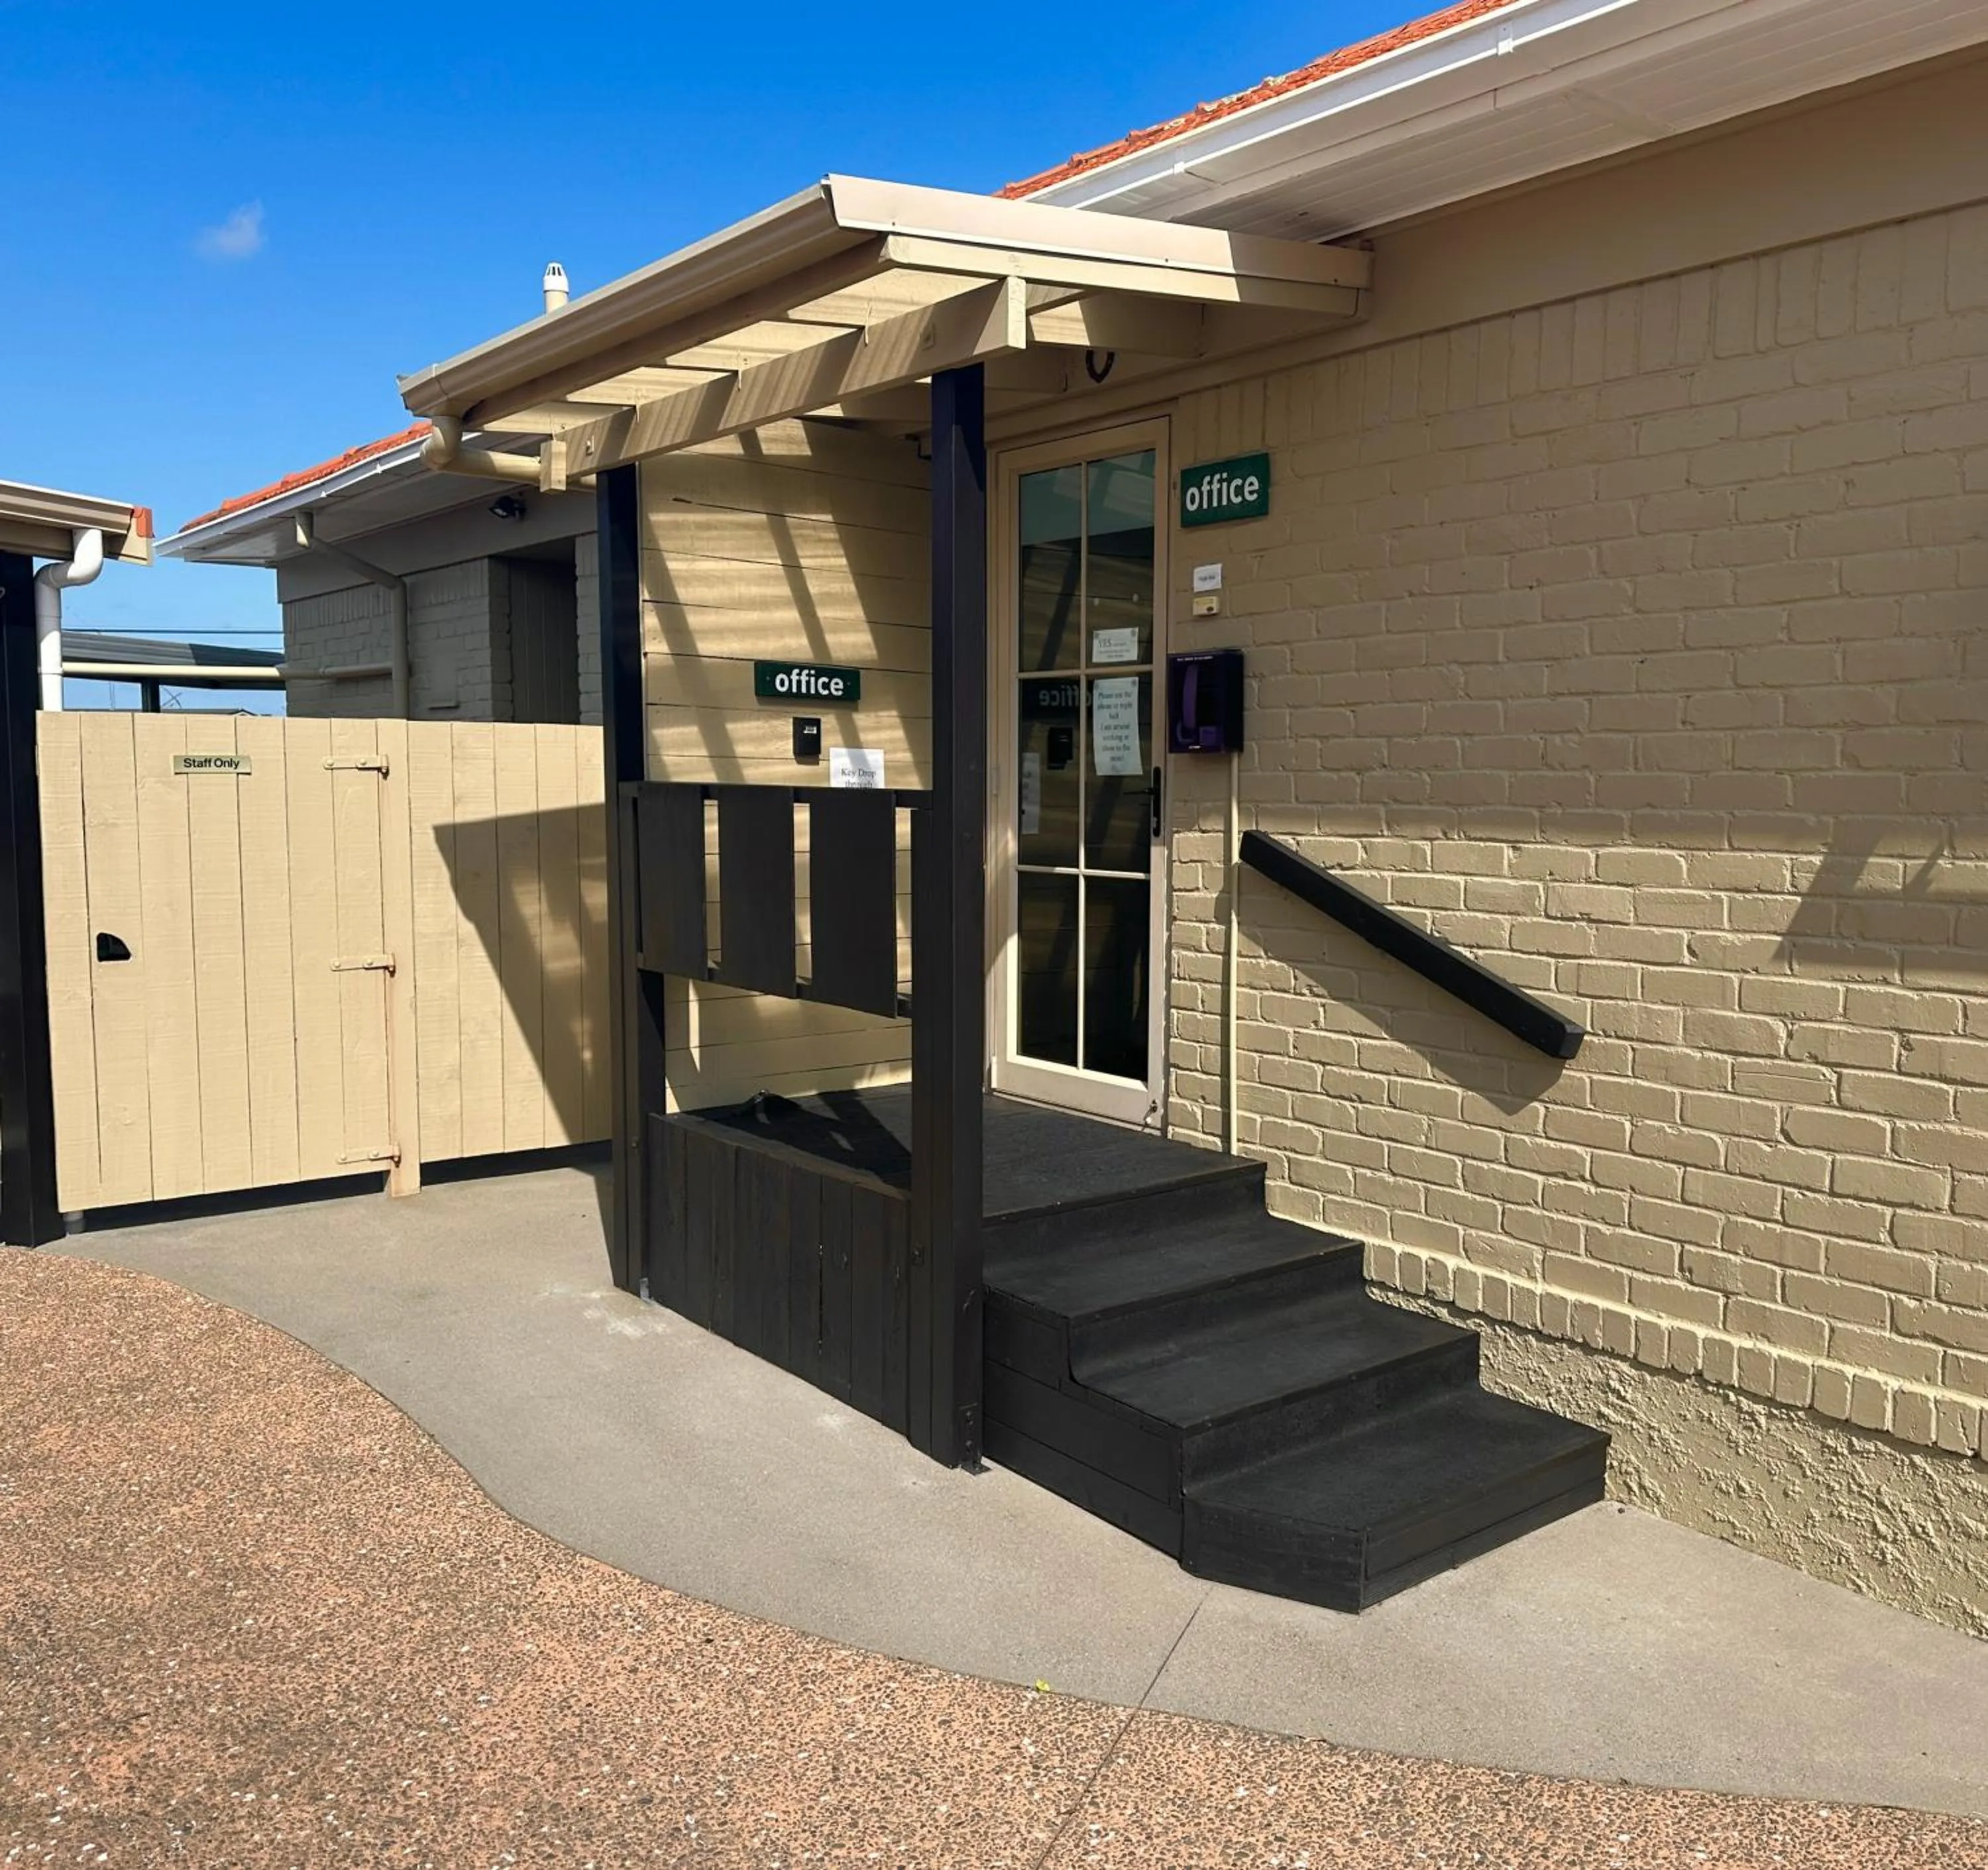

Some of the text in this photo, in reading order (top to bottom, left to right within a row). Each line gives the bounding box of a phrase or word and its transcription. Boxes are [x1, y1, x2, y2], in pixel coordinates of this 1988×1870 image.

[1186, 472, 1259, 512] office
[775, 669, 844, 696] office
[184, 758, 239, 769] Staff Only
[841, 768, 876, 779] Key Drop
